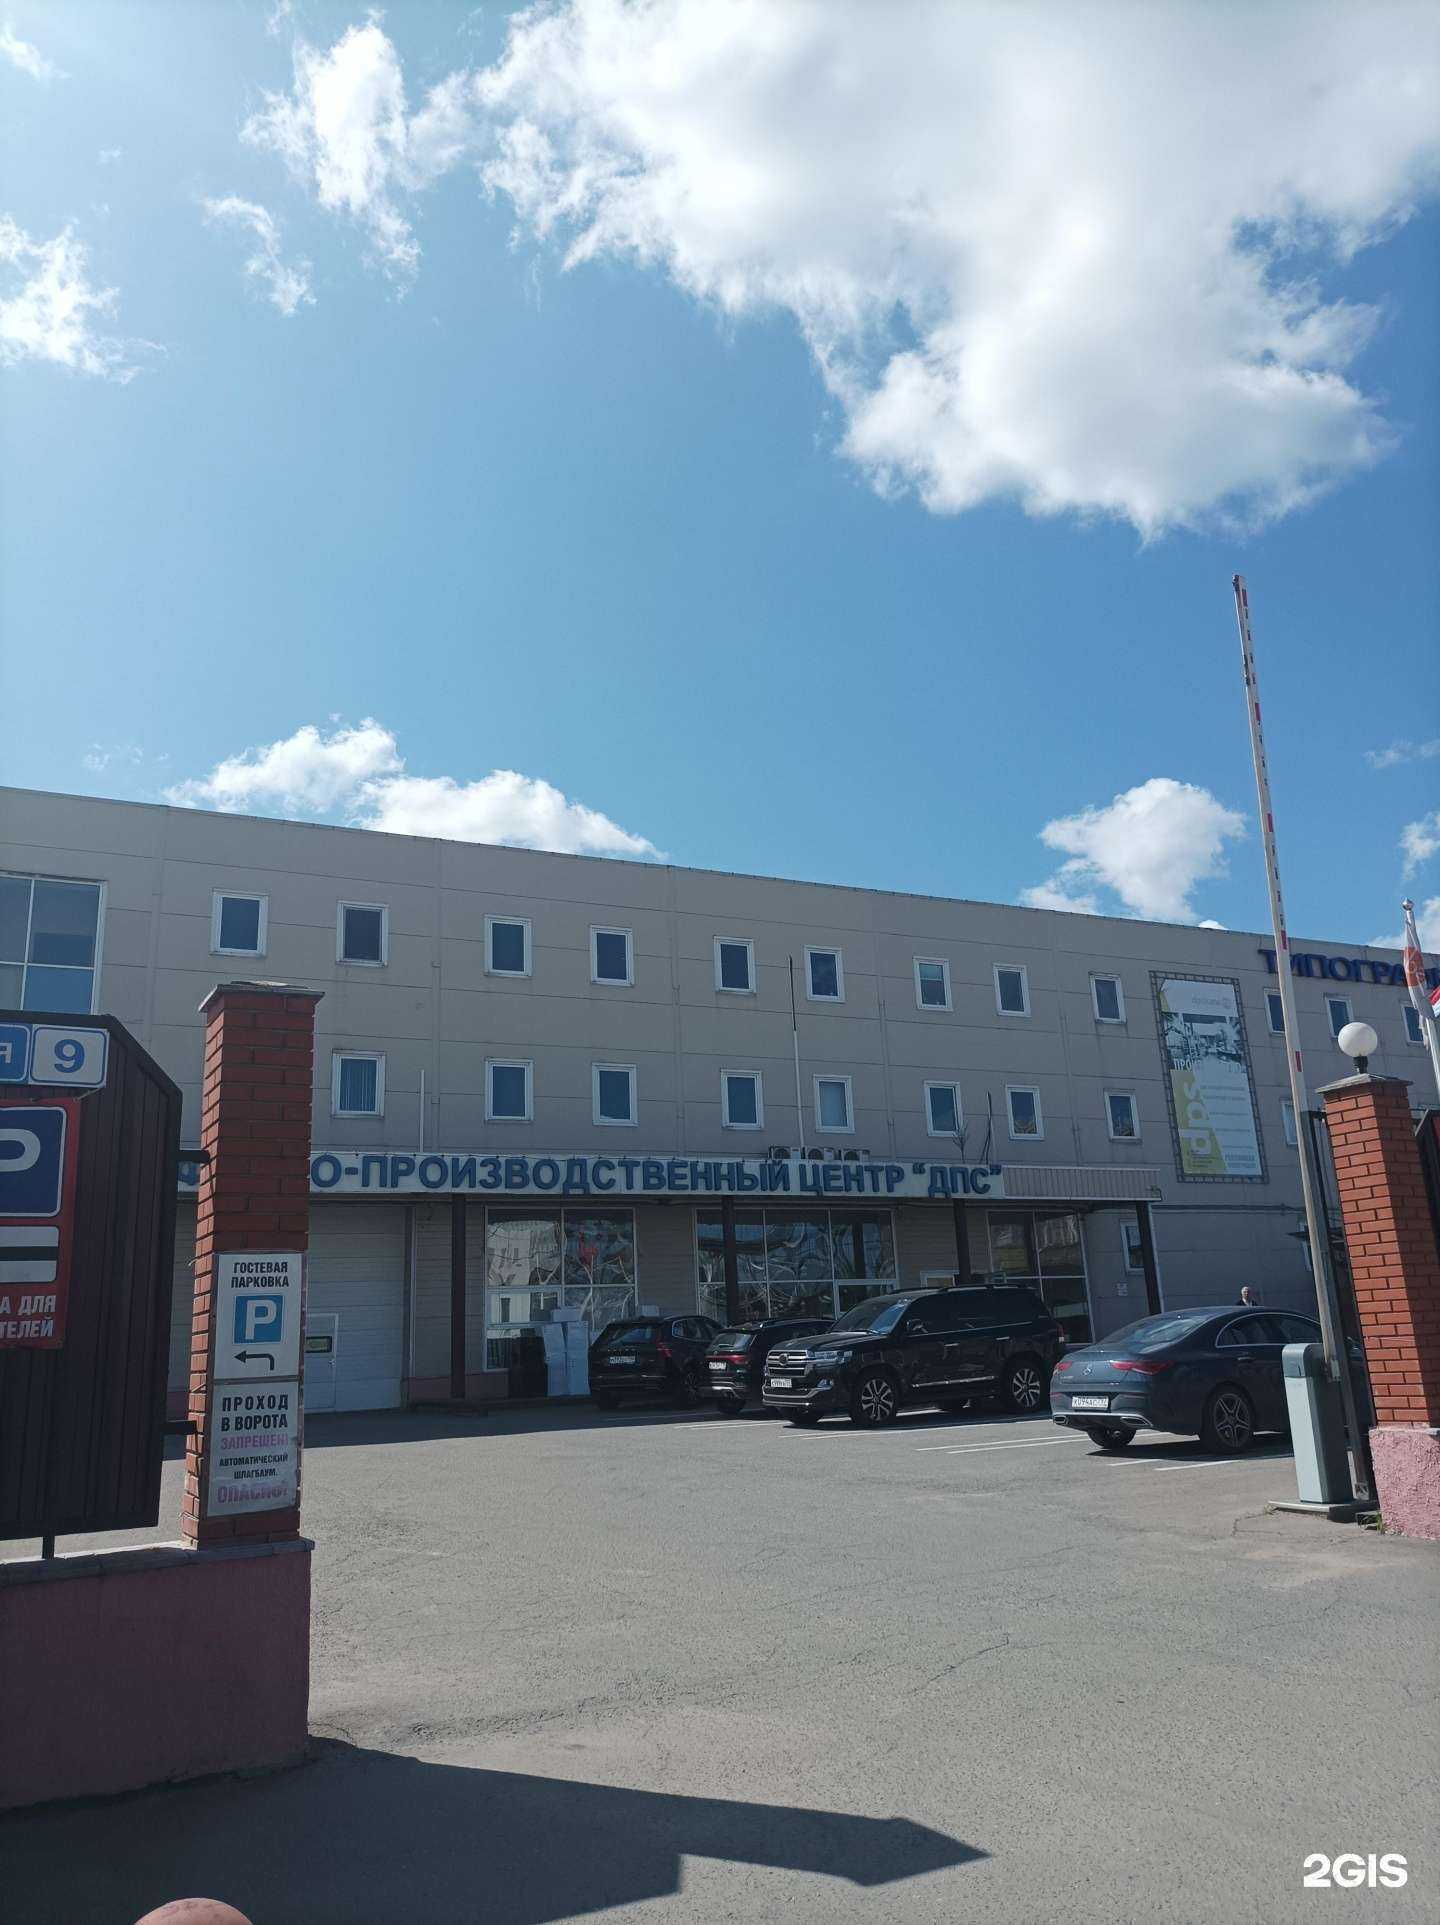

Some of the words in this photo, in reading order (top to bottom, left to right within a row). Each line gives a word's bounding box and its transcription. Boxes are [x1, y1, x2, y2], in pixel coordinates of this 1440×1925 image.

[54, 1038, 85, 1073] 9
[799, 1163, 905, 1198] ЦЕНТР
[233, 1261, 289, 1274] ГОСТЕВАЯ
[231, 1275, 290, 1289] ПАРКОВКА
[17, 1295, 57, 1316] ДЛЯ
[222, 1394, 289, 1412] ПРОХОД
[221, 1416, 230, 1432] В
[235, 1413, 288, 1431] ВОРОТА
[219, 1452, 289, 1467] АВТОМАТИЧЕСКИЙ
